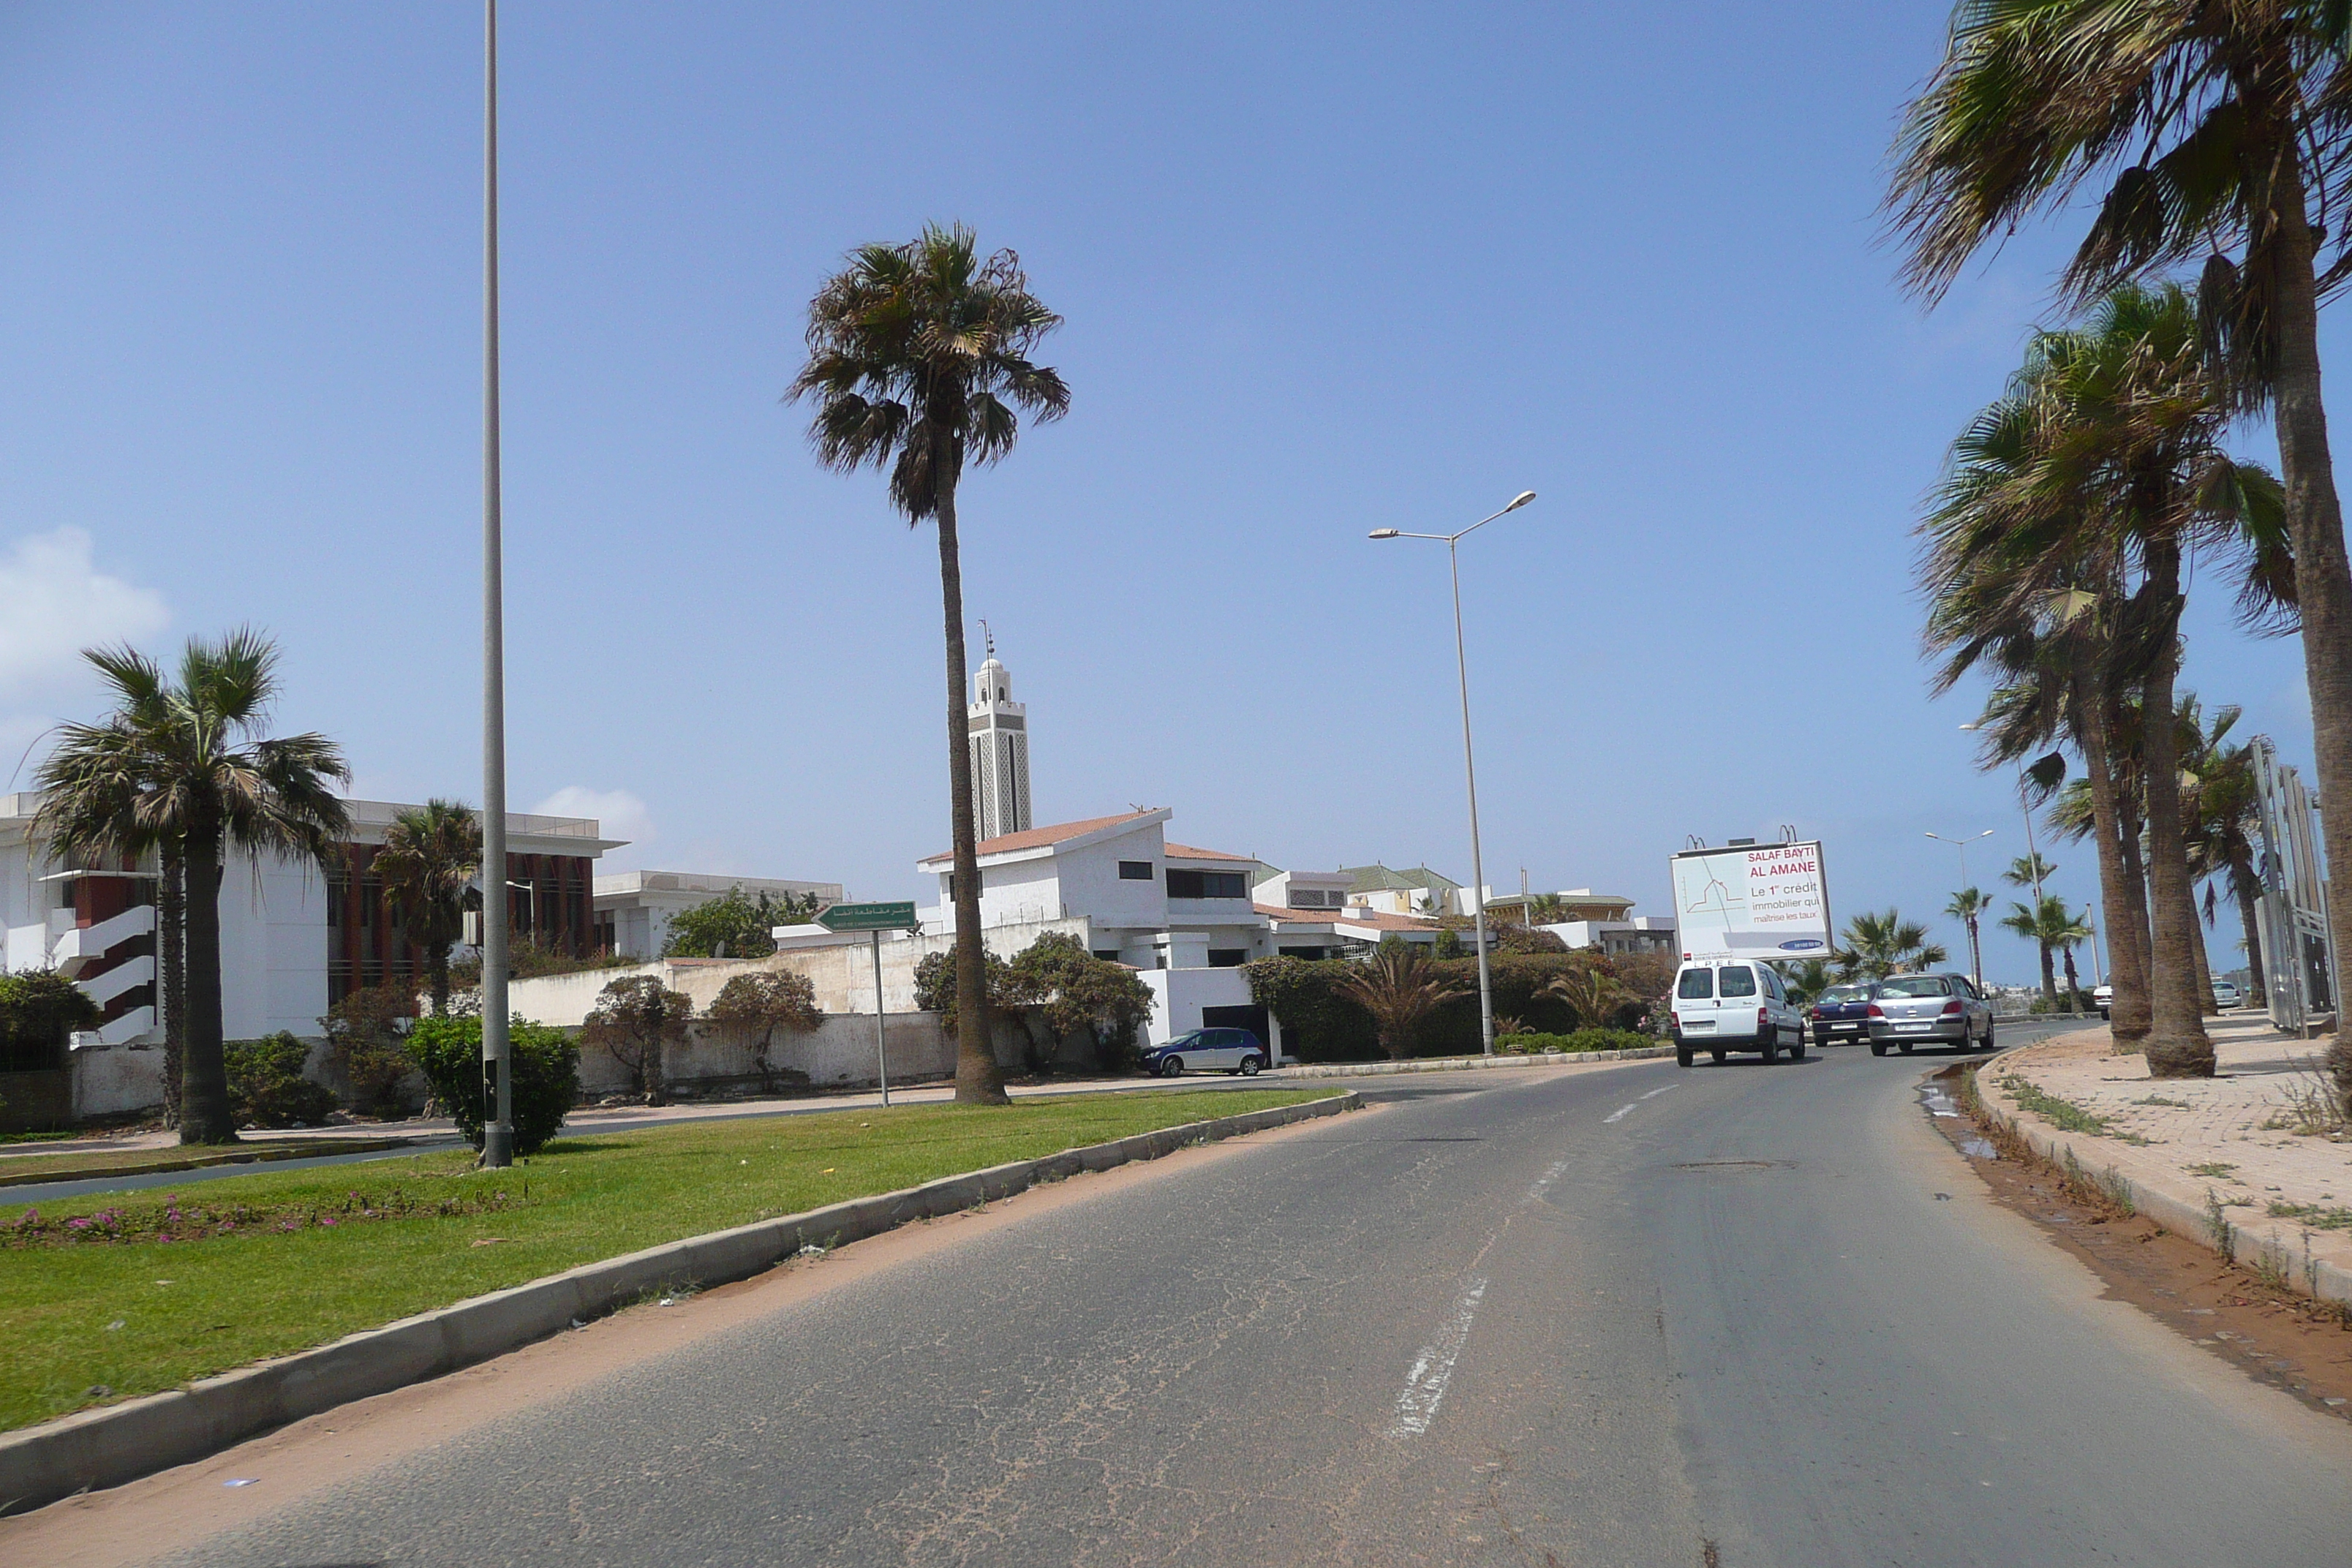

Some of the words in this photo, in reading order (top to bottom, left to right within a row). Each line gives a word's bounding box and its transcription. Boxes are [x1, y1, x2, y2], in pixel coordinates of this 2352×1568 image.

[1748, 851, 1781, 862] SALAF
[1784, 847, 1814, 859] BAYTI
[1750, 867, 1766, 878] AL
[1770, 861, 1815, 875] AMANE
[1751, 887, 1765, 897] Le
[1783, 882, 1817, 894] crédit
[1752, 899, 1802, 911] immobilier
[1804, 898, 1820, 908] qui
